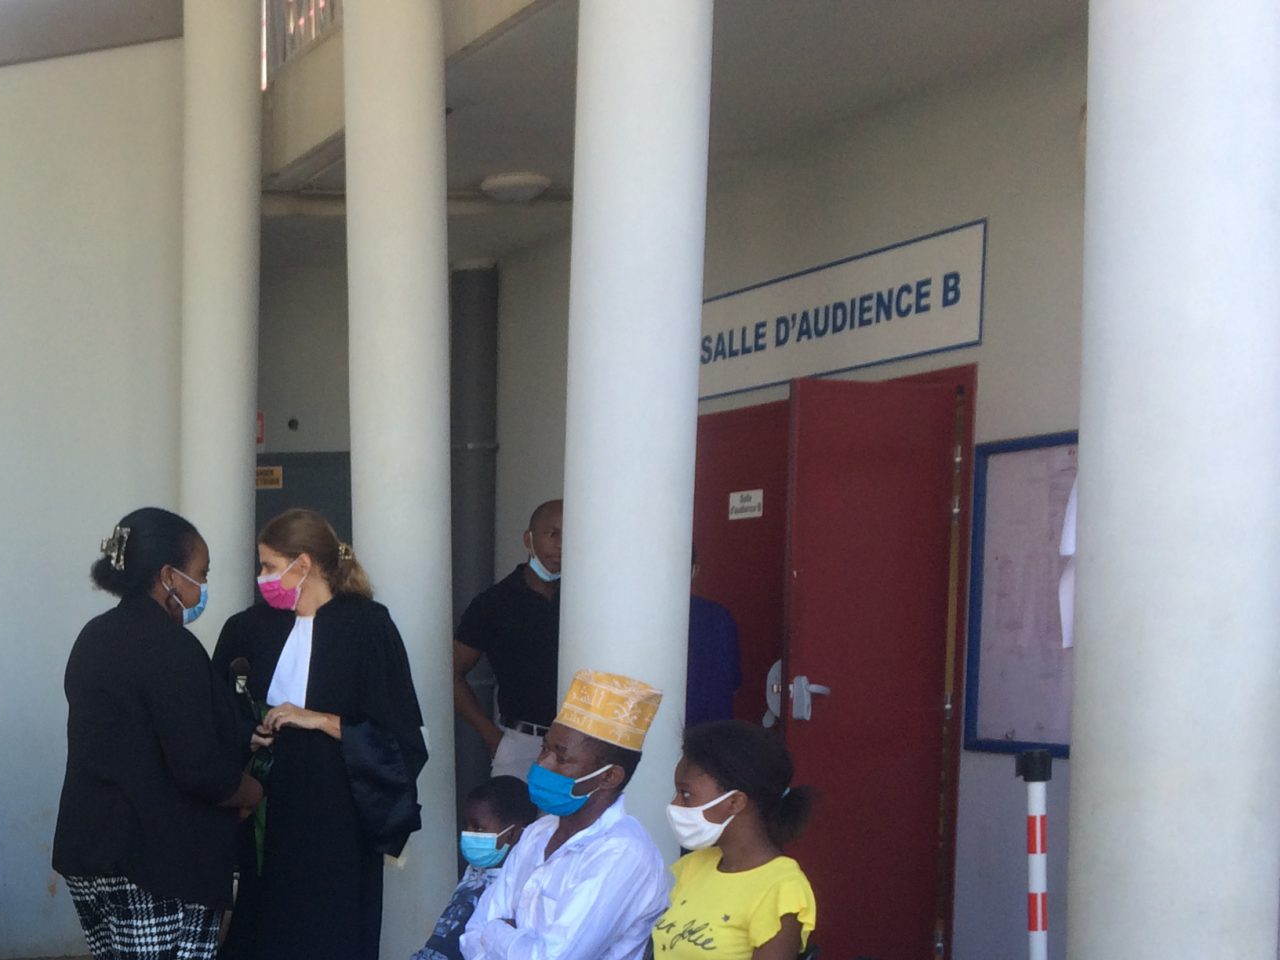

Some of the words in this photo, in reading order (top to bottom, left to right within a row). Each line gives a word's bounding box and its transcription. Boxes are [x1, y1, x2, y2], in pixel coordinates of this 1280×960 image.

[700, 321, 767, 365] SALLE
[775, 277, 932, 348] D'AUDIENCE
[942, 271, 961, 308] B
